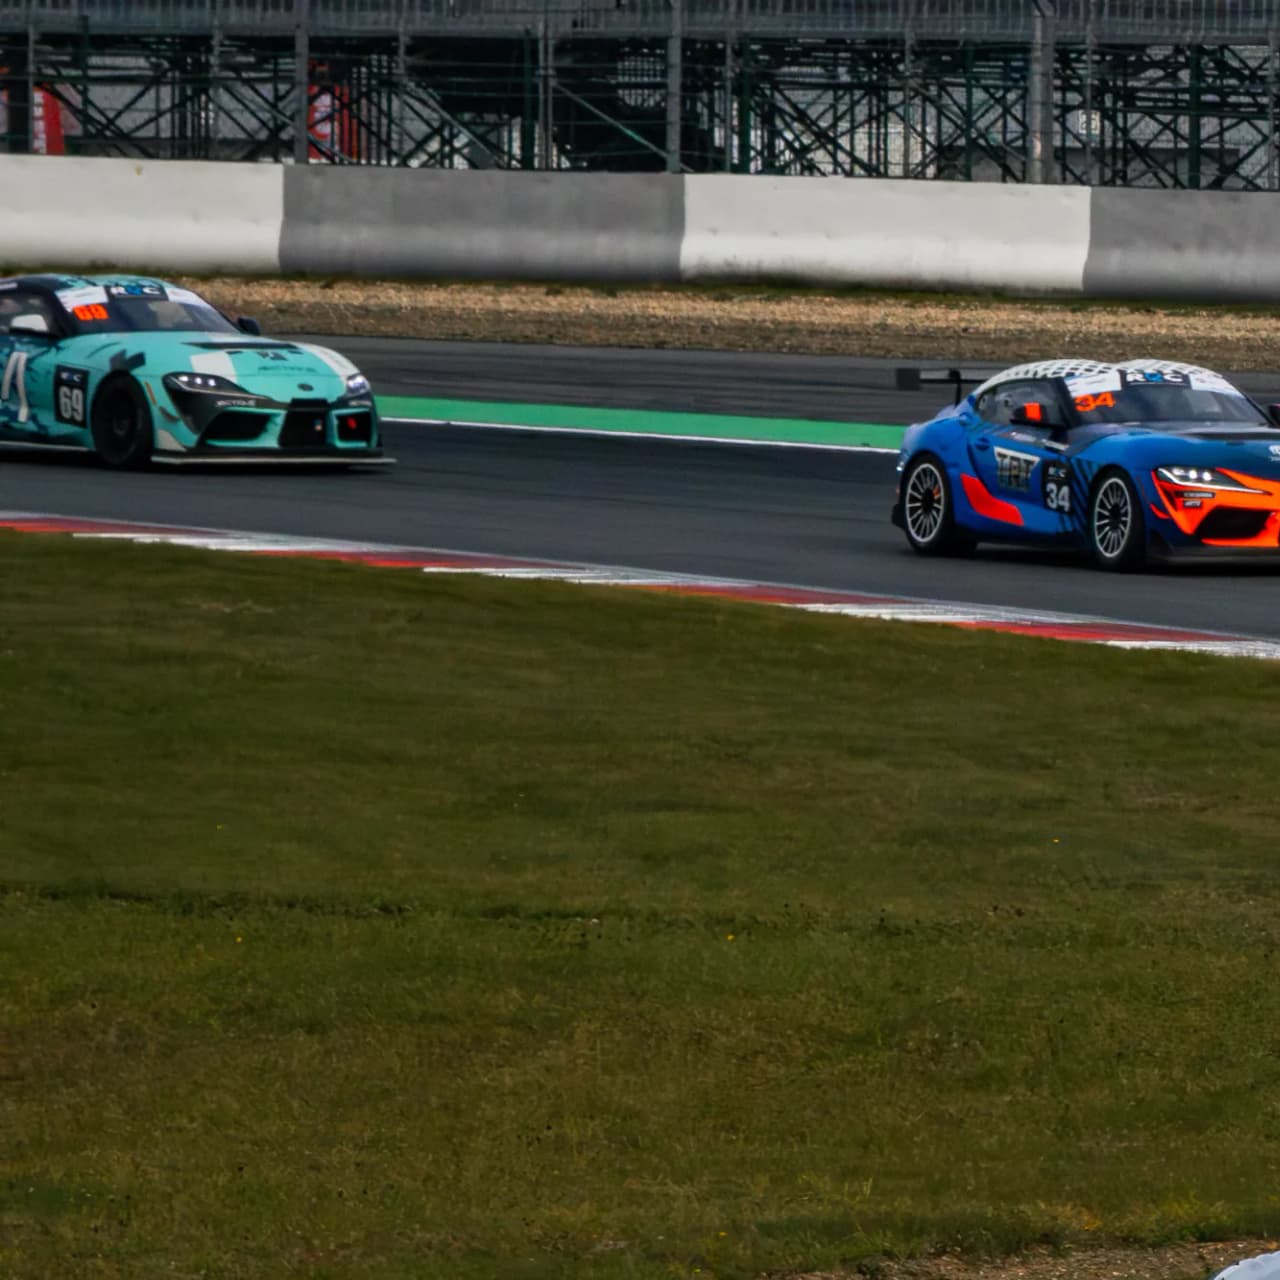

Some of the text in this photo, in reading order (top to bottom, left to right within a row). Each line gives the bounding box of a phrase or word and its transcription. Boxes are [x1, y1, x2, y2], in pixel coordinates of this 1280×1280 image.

[58, 386, 83, 422] 69
[1075, 391, 1116, 412] 34
[1046, 482, 1070, 512] 34
